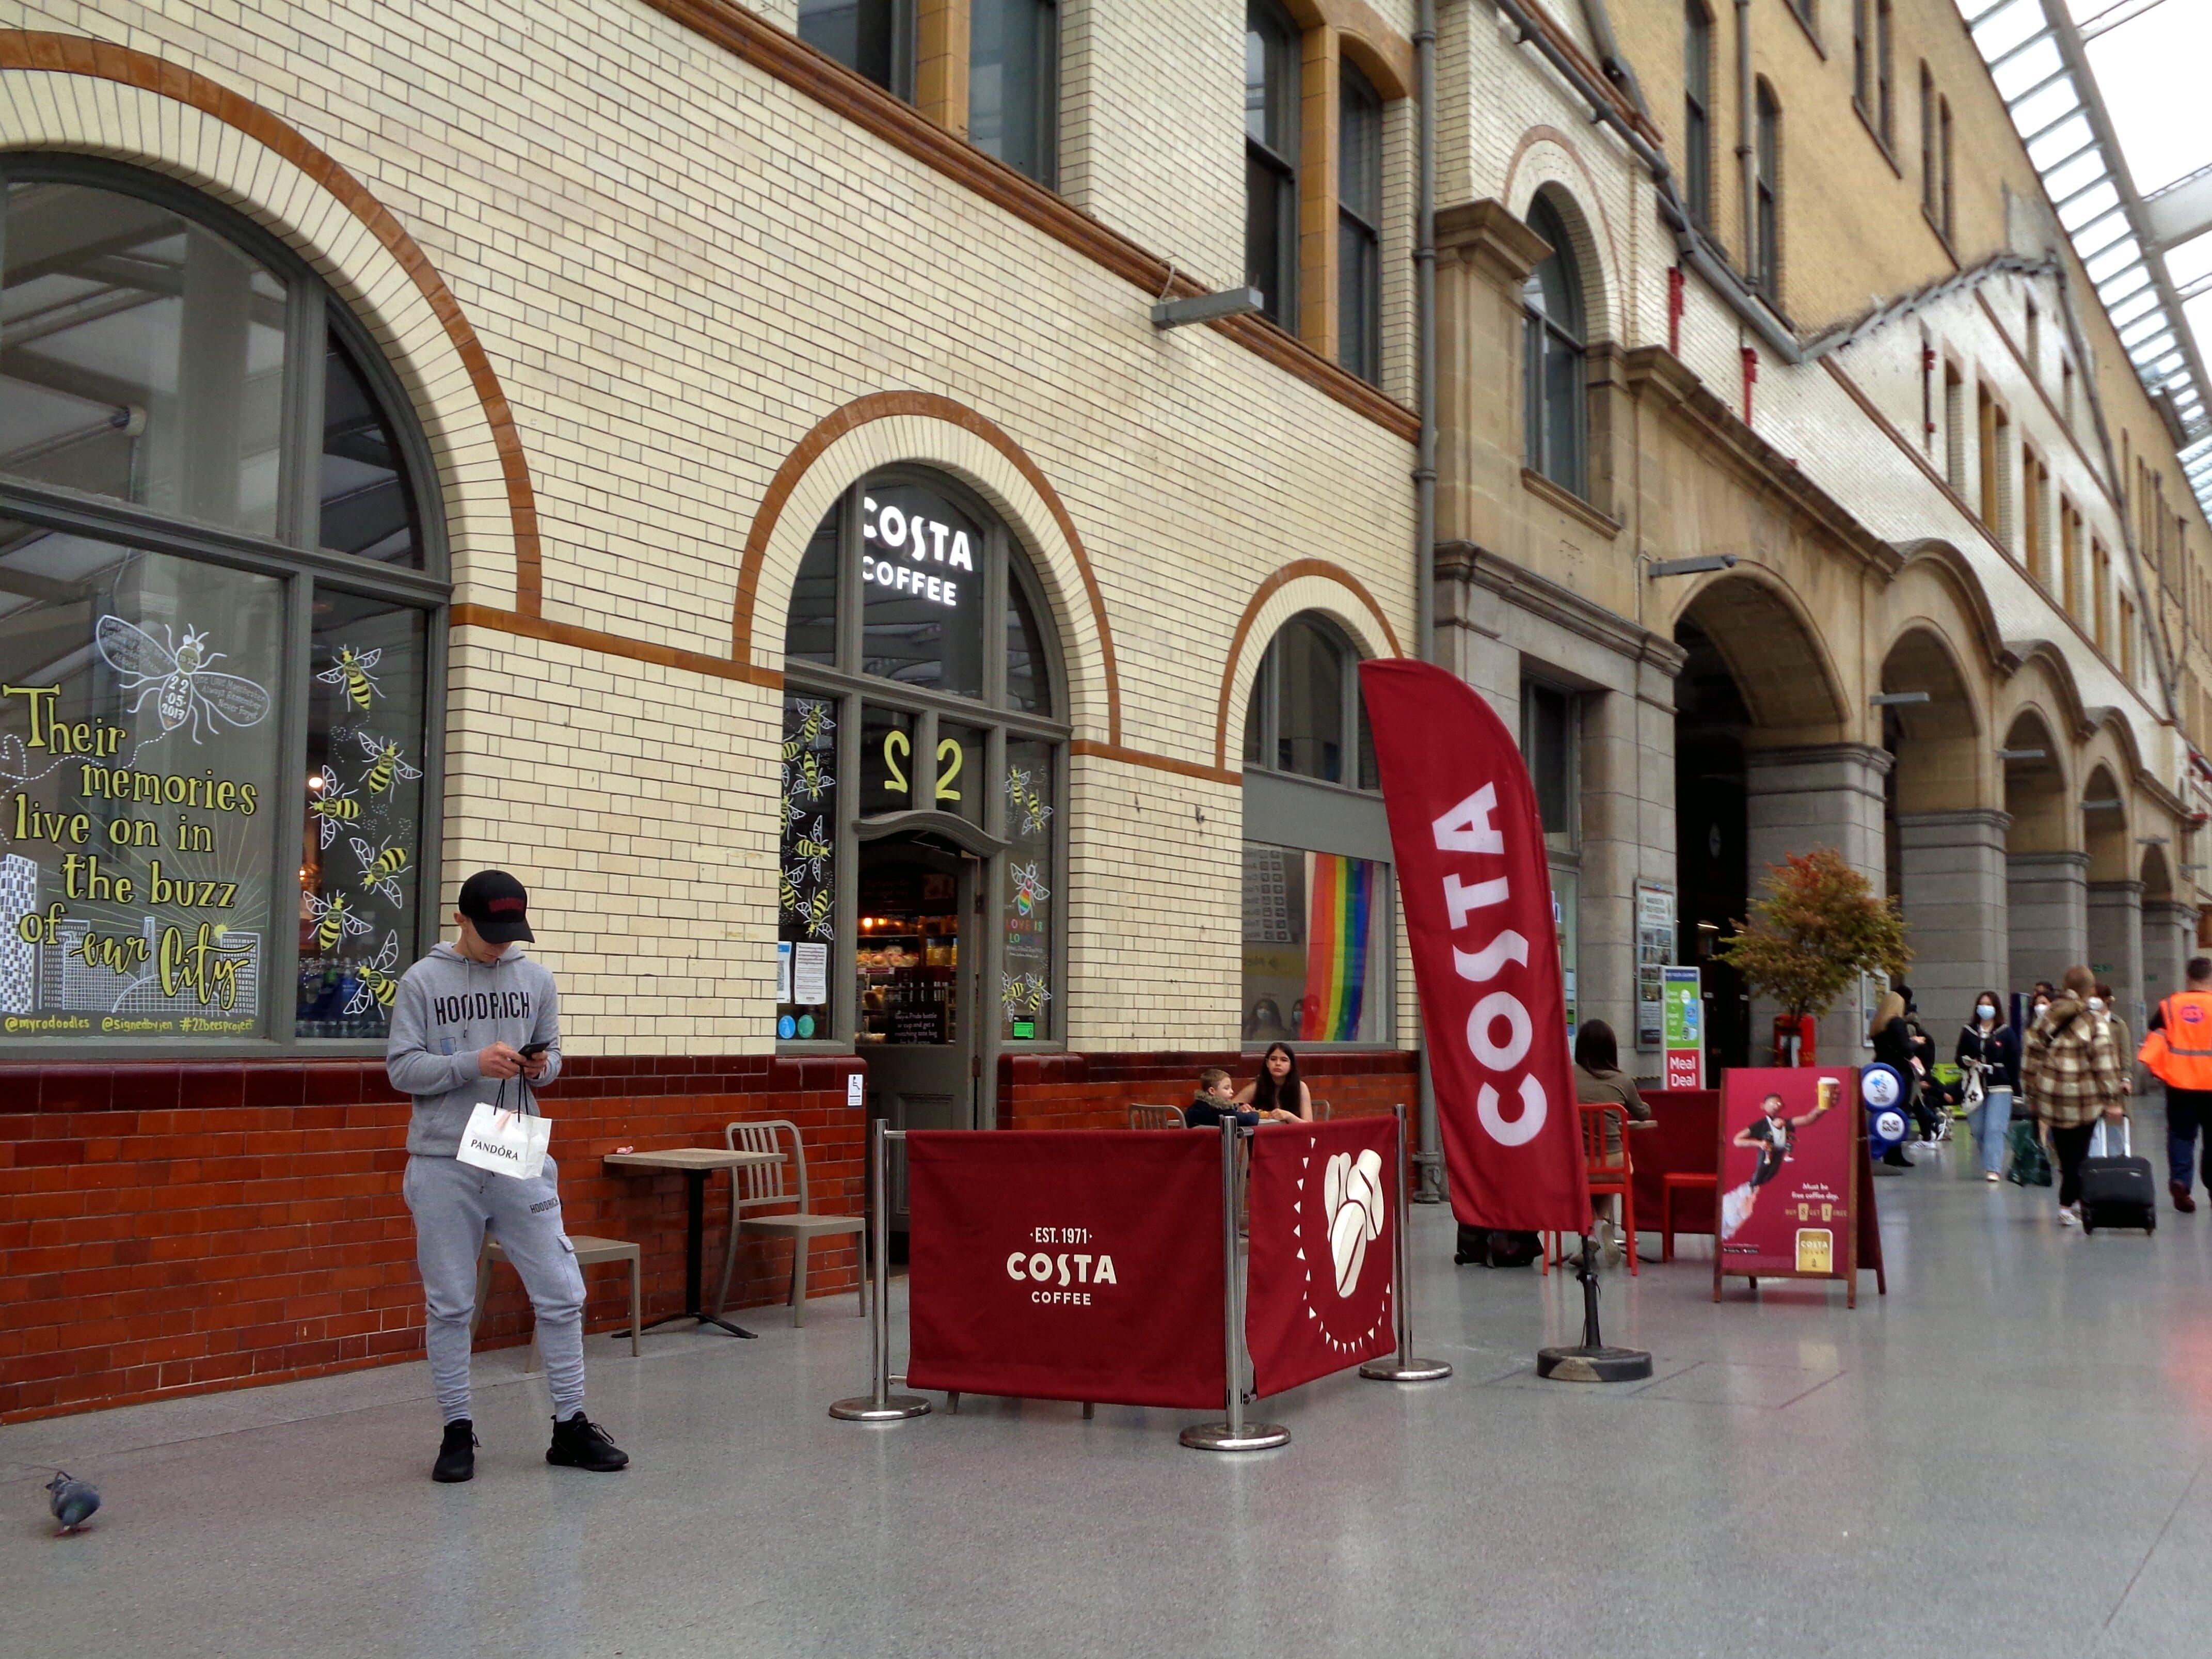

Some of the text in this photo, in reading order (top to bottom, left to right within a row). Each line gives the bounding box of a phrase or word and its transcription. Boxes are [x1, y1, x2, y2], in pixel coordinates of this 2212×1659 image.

[2, 684, 126, 757] Their
[162, 704, 186, 720] 2017
[81, 764, 258, 816] memories
[14, 793, 214, 852] live on in
[60, 854, 237, 908] the buzz
[19, 903, 68, 945] of
[69, 922, 256, 1010] our City
[1431, 781, 1548, 1147] COSTA
[434, 991, 530, 1025] HOODRICH
[1669, 1055, 1696, 1070] Meal
[1670, 1072, 1697, 1087] Deal
[471, 1139, 518, 1160] PANDORA
[1802, 1182, 1828, 1191] Must be
[1805, 1191, 1825, 1199] coffee
[1035, 1227, 1087, 1244] EST. 1971
[1007, 1252, 1117, 1287] COSTA
[1031, 1291, 1091, 1306] COFFEE
